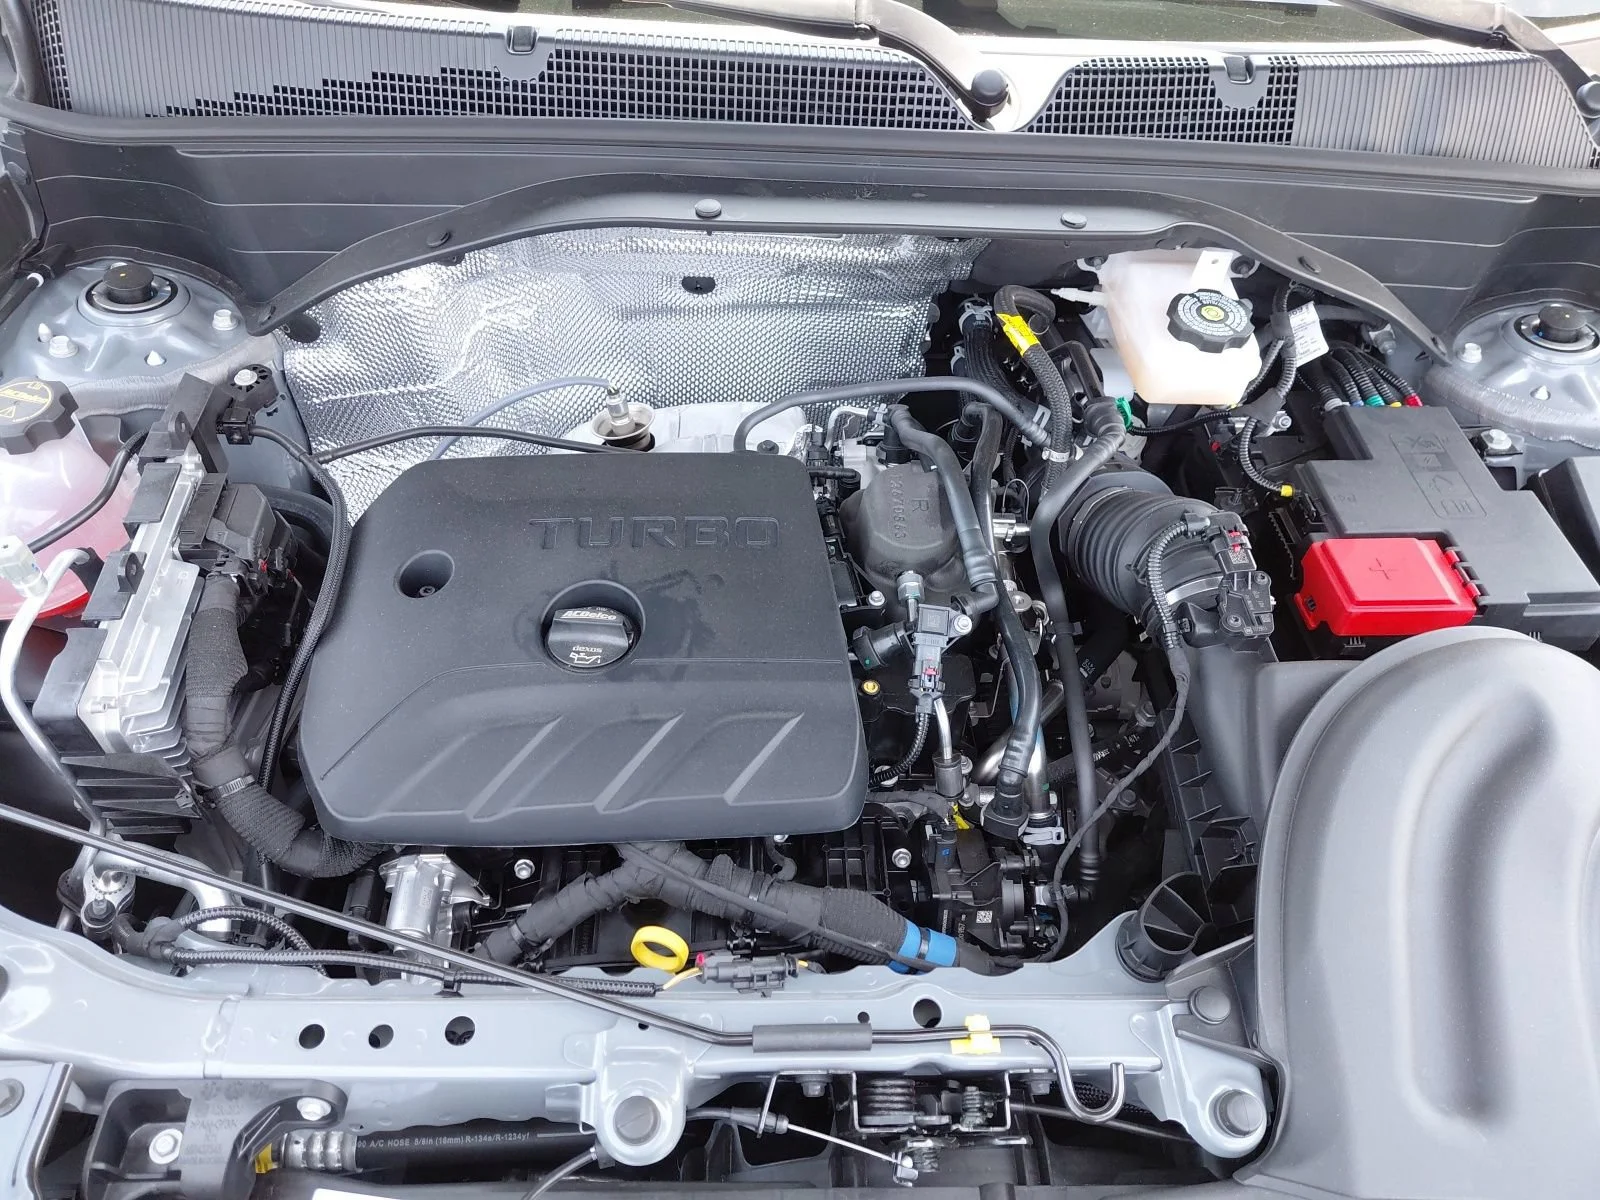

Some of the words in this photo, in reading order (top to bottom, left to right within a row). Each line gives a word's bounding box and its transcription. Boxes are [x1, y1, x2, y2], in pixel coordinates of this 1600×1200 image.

[529, 516, 780, 550] TURBO
[560, 610, 617, 621] ACDelco
[572, 645, 603, 653] dexos
[369, 1139, 384, 1148] A/C
[387, 1138, 410, 1147] HOSE
